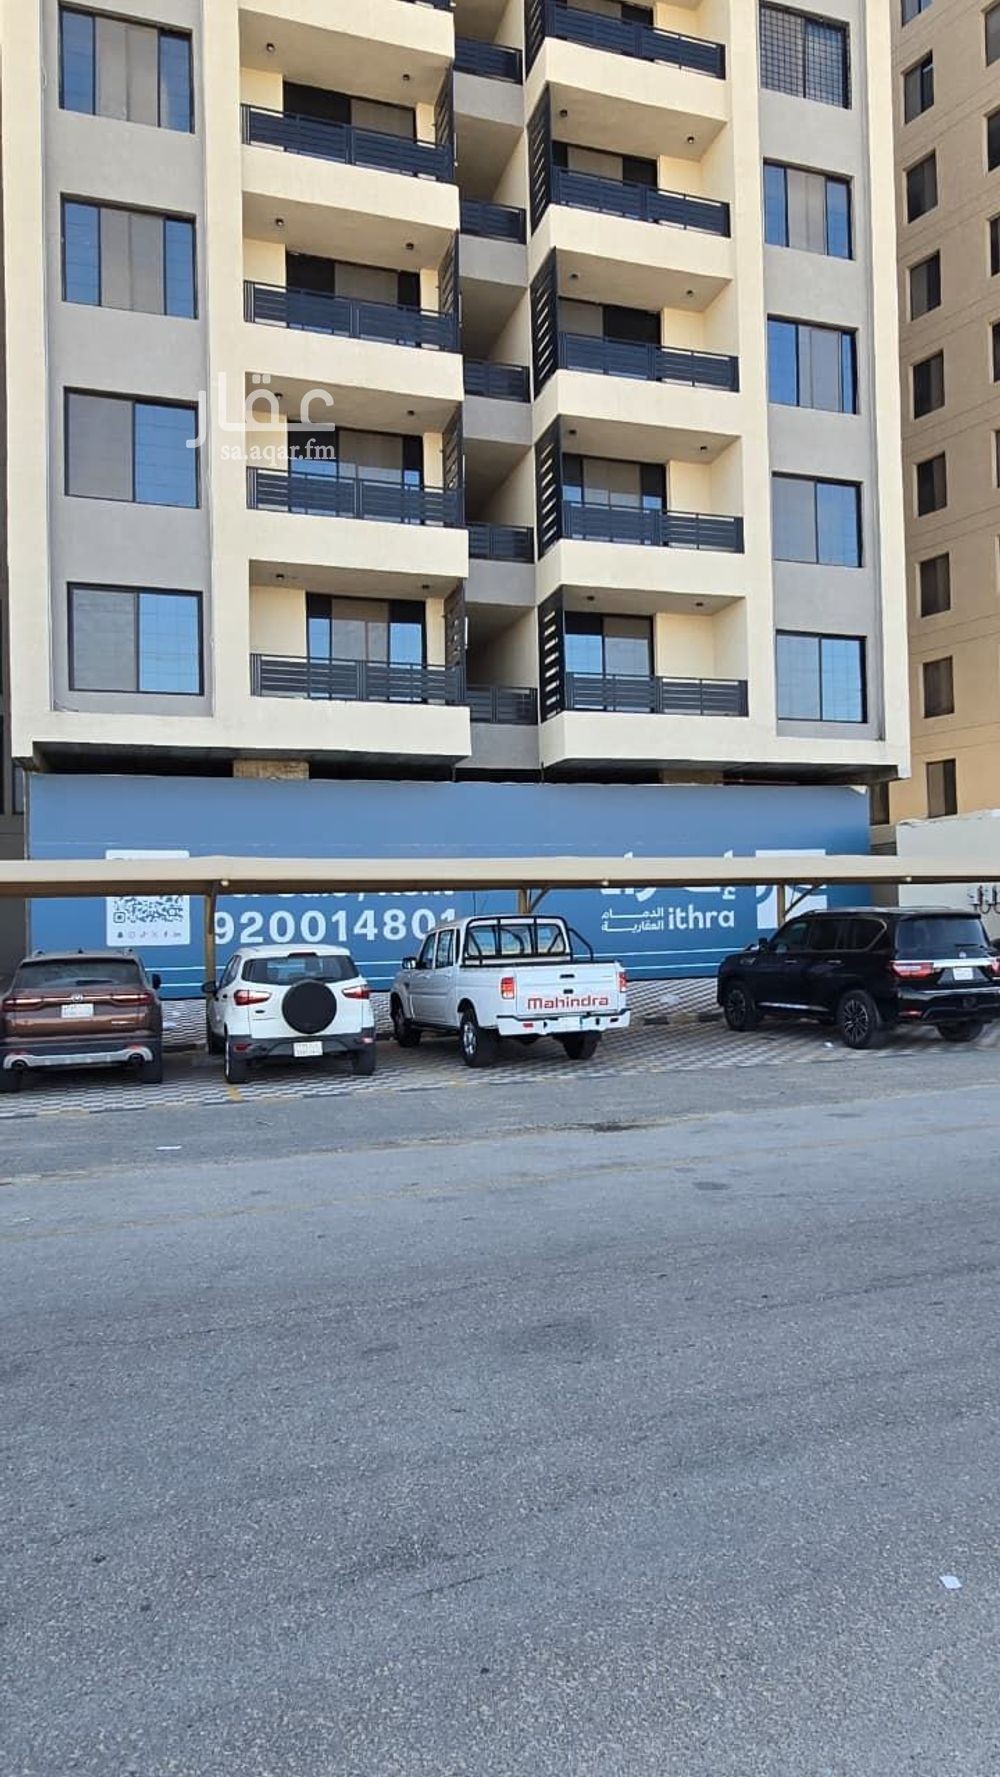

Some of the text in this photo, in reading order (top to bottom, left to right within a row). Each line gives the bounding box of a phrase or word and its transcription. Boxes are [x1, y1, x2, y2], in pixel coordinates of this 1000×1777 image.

[601, 907, 664, 919] الدمام
[668, 904, 735, 930] ithra
[601, 920, 664, 933] العقارية
[527, 995, 609, 1010] Mahindra
